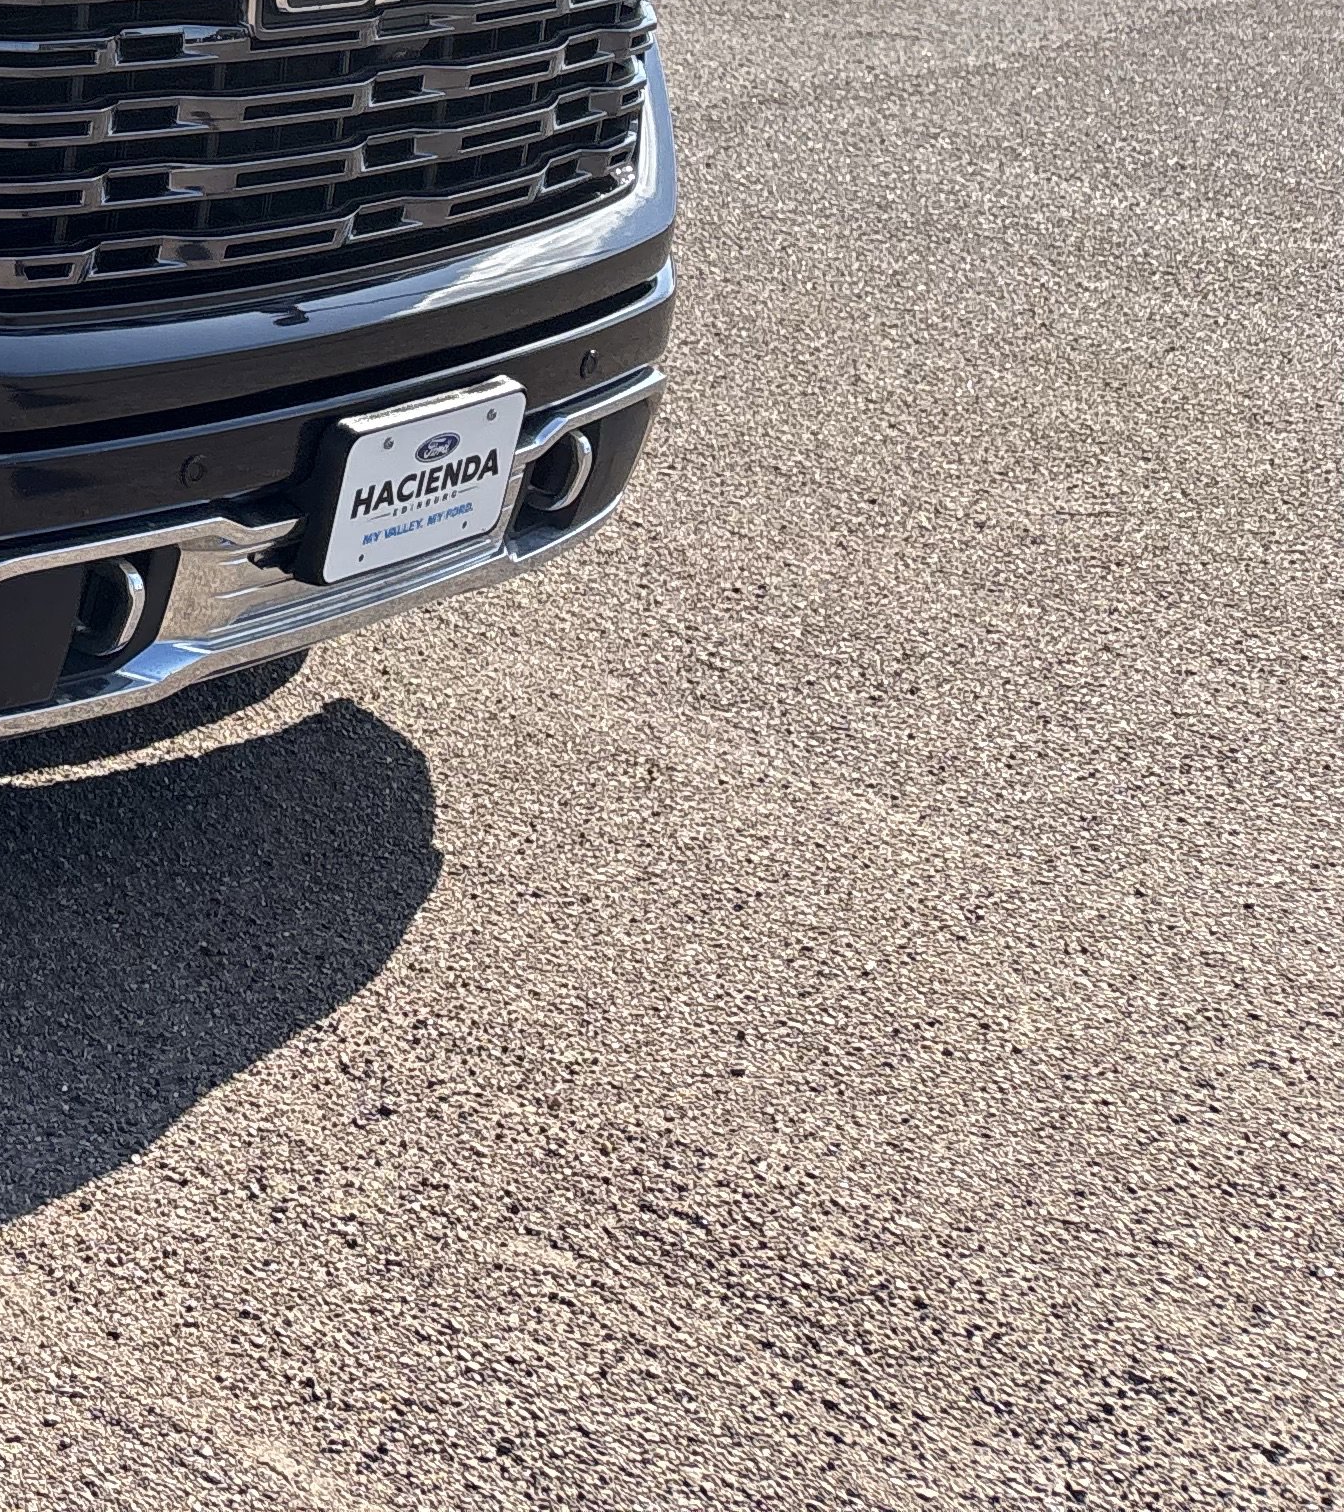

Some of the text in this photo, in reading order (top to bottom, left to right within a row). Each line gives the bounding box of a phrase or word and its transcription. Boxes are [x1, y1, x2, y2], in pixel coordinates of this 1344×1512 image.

[349, 448, 499, 520] HACIENDA
[392, 490, 457, 517] EDINBURG
[363, 531, 381, 545] MY
[427, 511, 443, 526] MY
